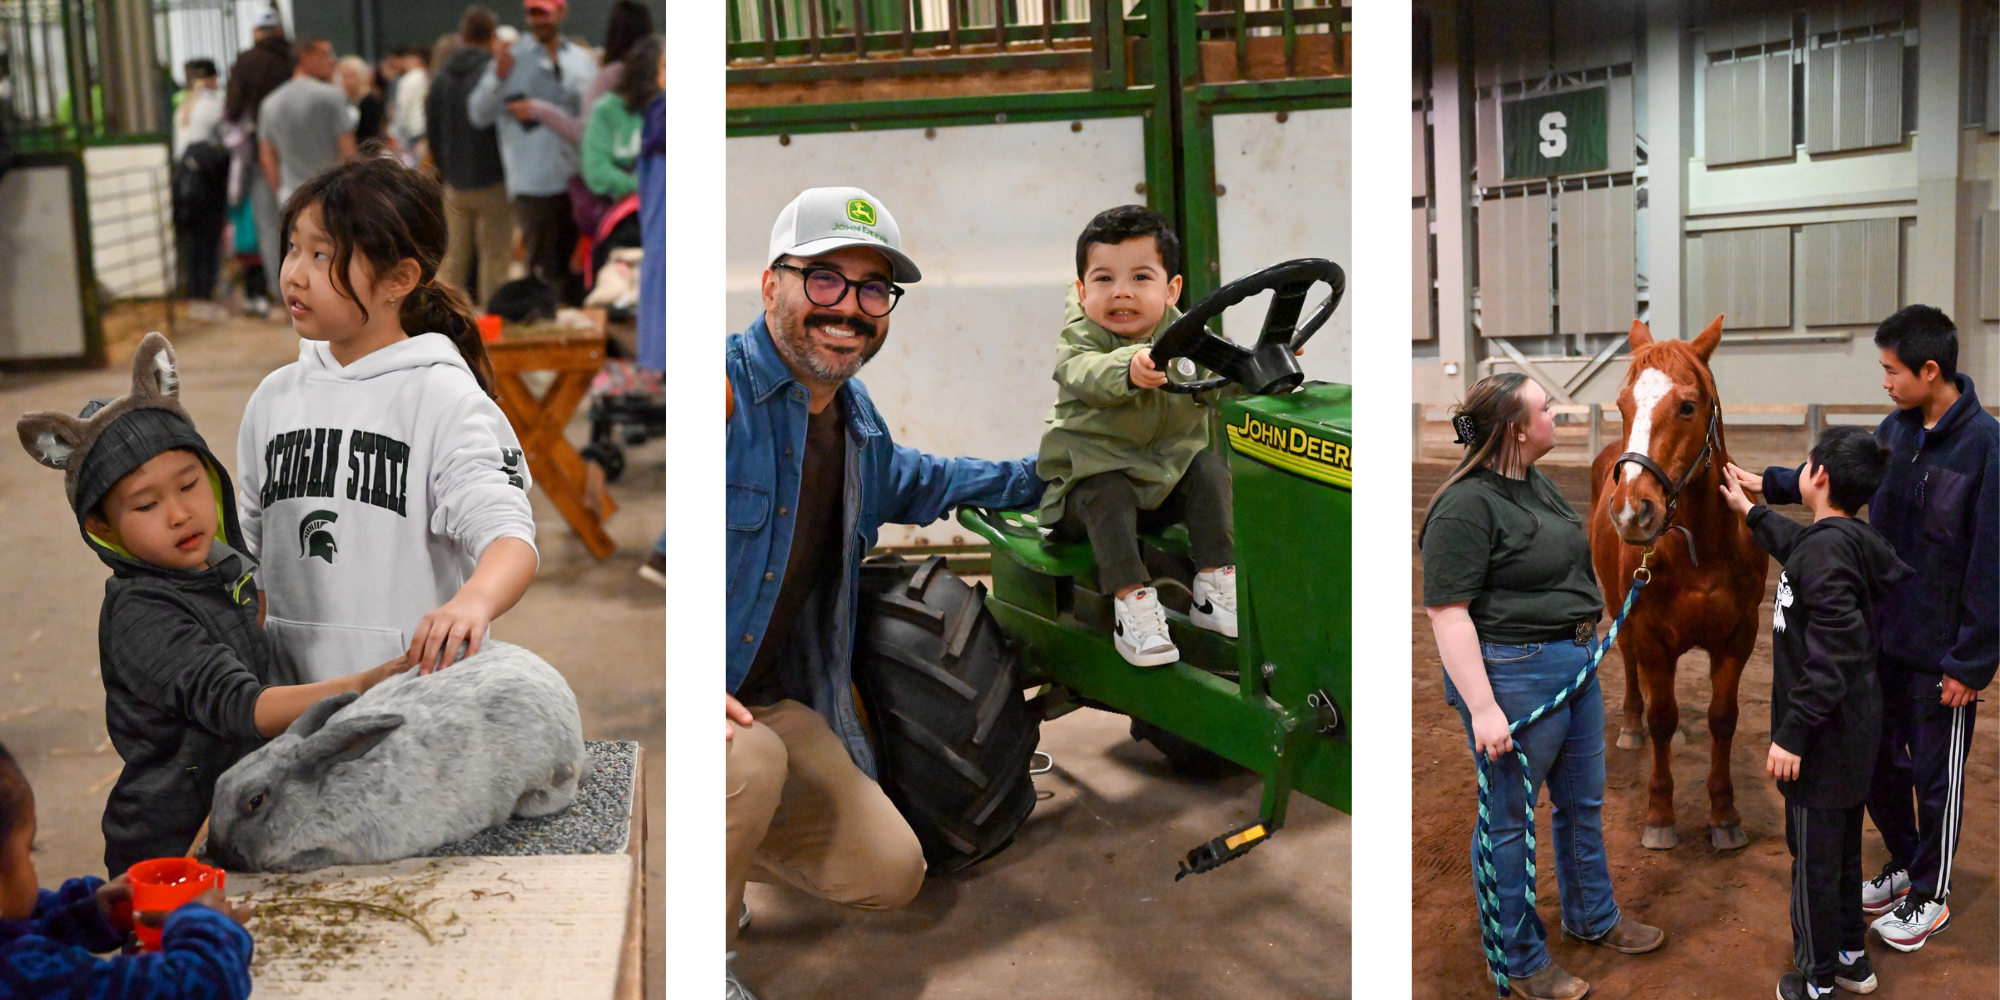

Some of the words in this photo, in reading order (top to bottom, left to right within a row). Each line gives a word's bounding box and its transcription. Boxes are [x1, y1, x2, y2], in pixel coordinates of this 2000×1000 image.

[1539, 111, 1567, 158] S
[831, 222, 862, 232] JOHN
[1238, 412, 1287, 450] JOHN
[1289, 426, 1352, 469] DEER
[260, 428, 342, 510] ICHIGAN
